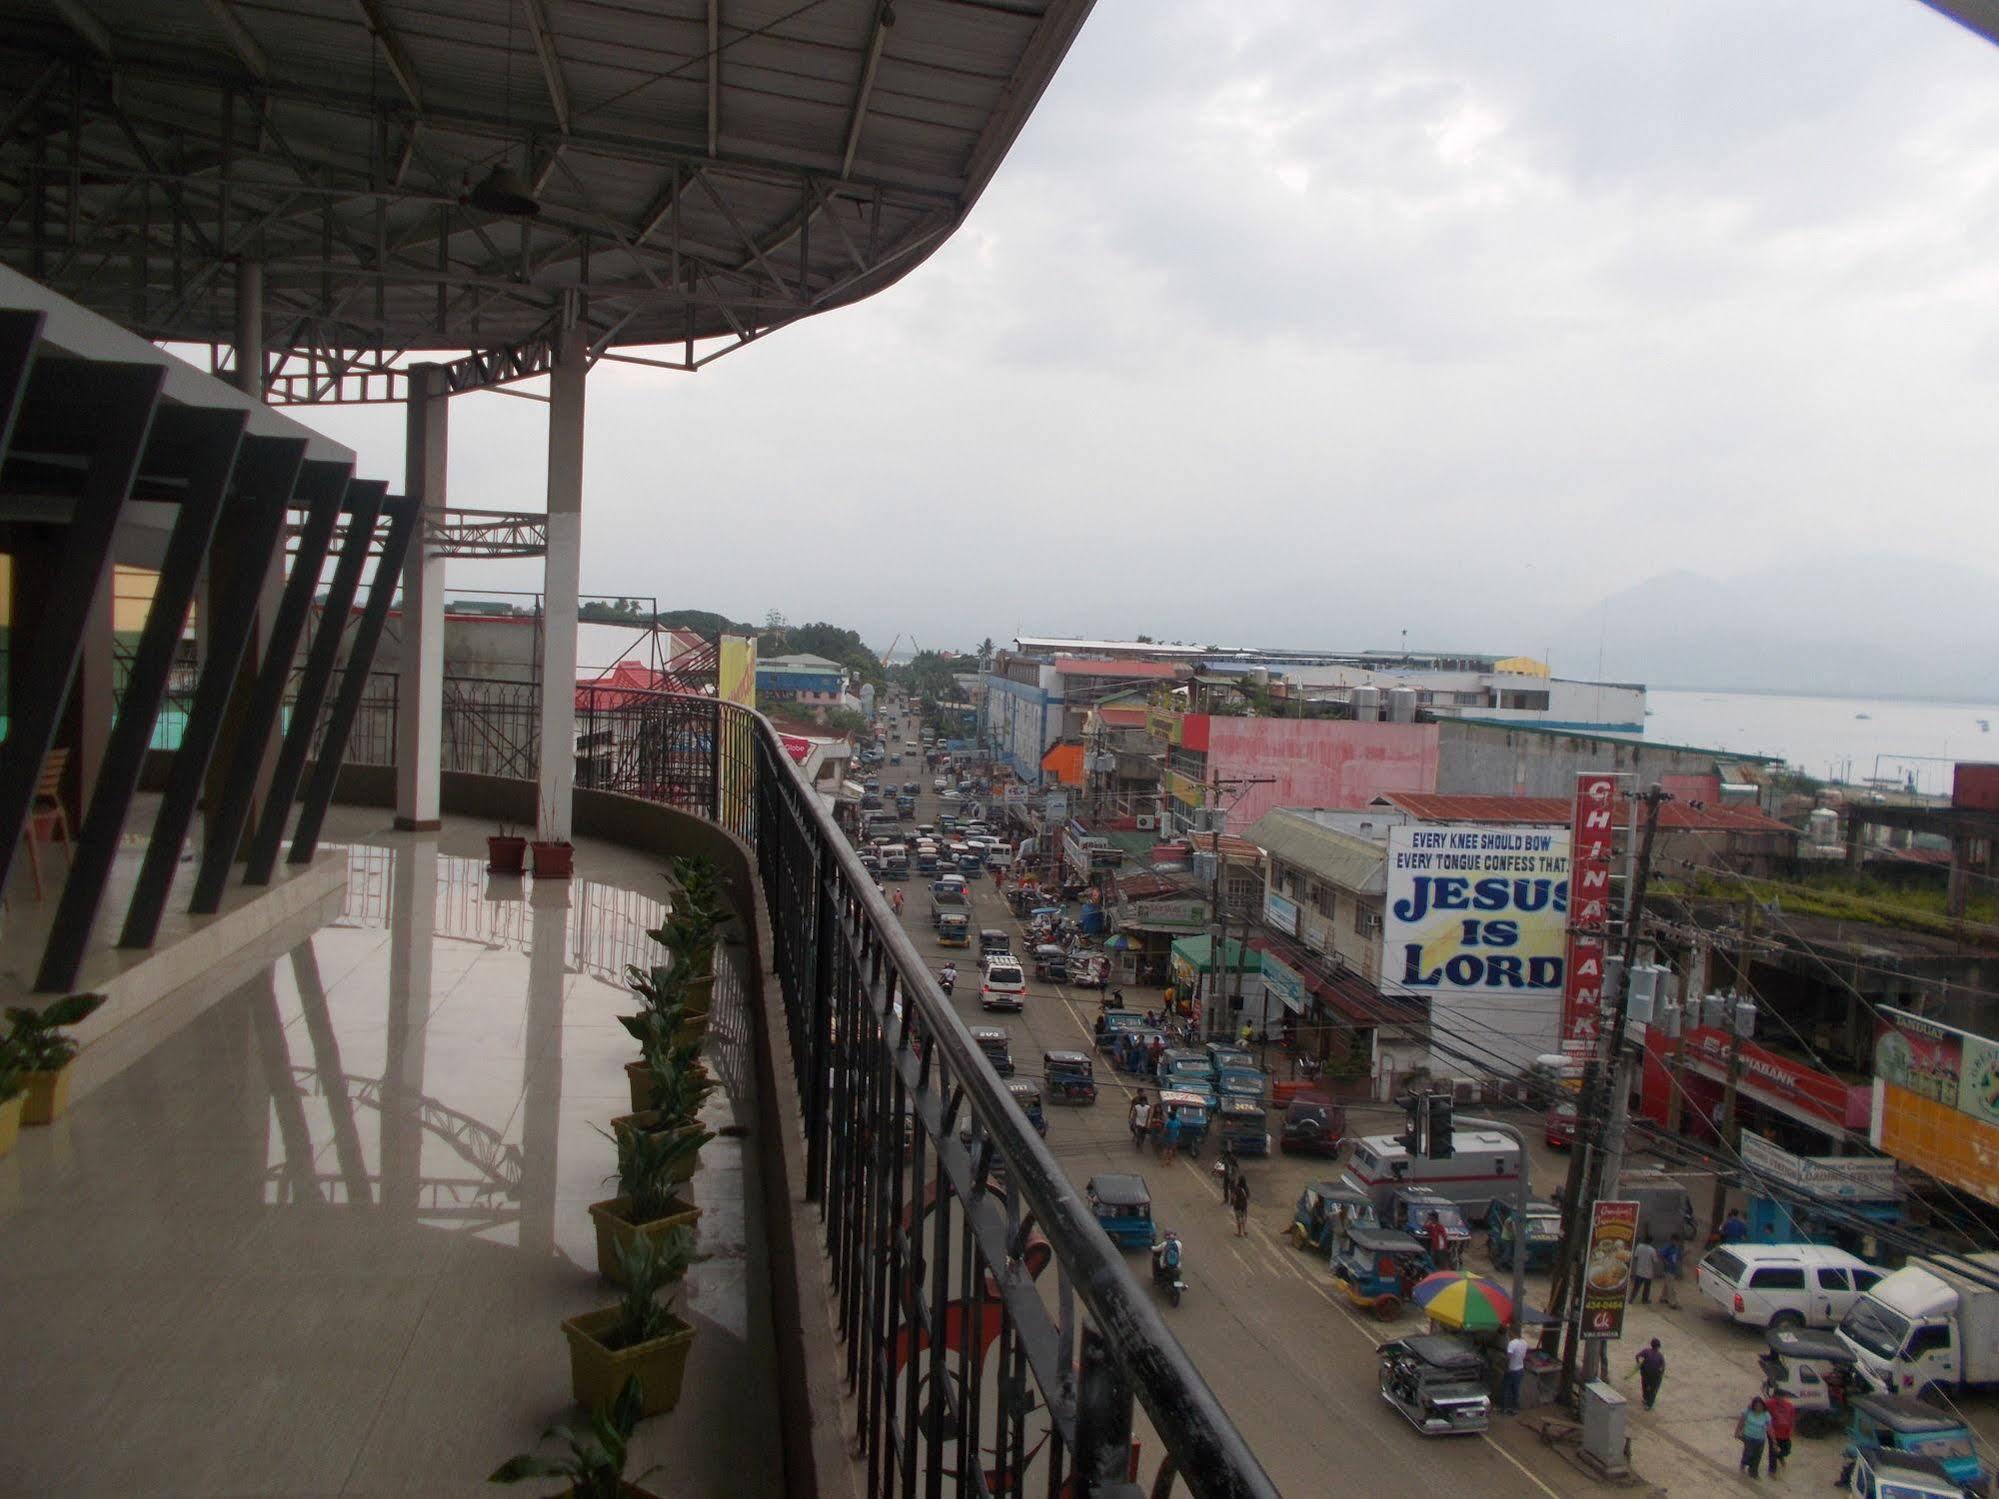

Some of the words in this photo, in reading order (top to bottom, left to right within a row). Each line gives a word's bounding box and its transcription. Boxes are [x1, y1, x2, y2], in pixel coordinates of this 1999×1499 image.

[1412, 832, 1447, 849] EVERY
[1450, 833, 1477, 850] KNEE
[1480, 833, 1522, 851] SHOULD
[1524, 835, 1552, 851] BOW
[1396, 852, 1432, 869] EVERY
[1436, 853, 1481, 871] TONGUE
[1484, 855, 1535, 872] CONFESS
[1460, 919, 1518, 946] IS
[1402, 944, 1563, 988] LORD
